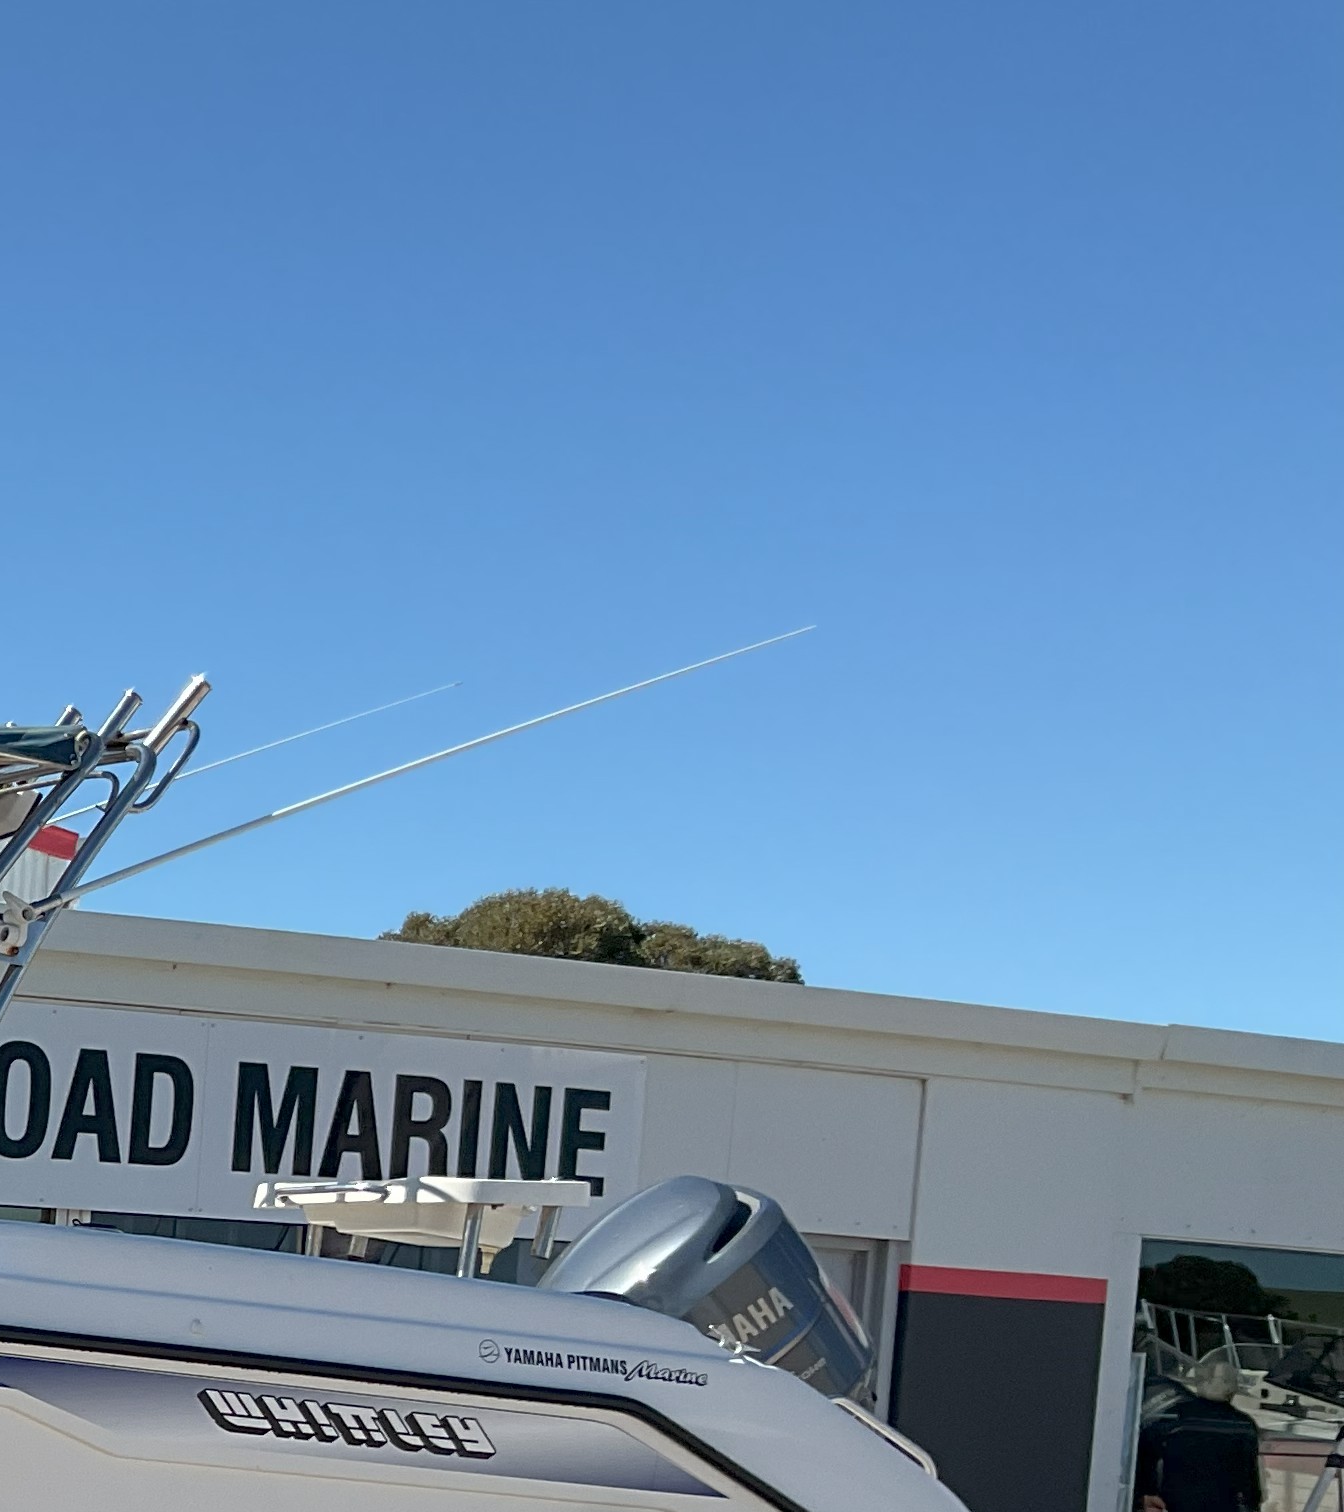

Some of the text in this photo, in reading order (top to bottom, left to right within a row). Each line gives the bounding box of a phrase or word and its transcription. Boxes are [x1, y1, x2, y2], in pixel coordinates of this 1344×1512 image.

[231, 1061, 612, 1197] MARINE
[504, 1347, 709, 1387] YAMAHA PITMANS Marine
[197, 1388, 497, 1459] WHITTLEY
